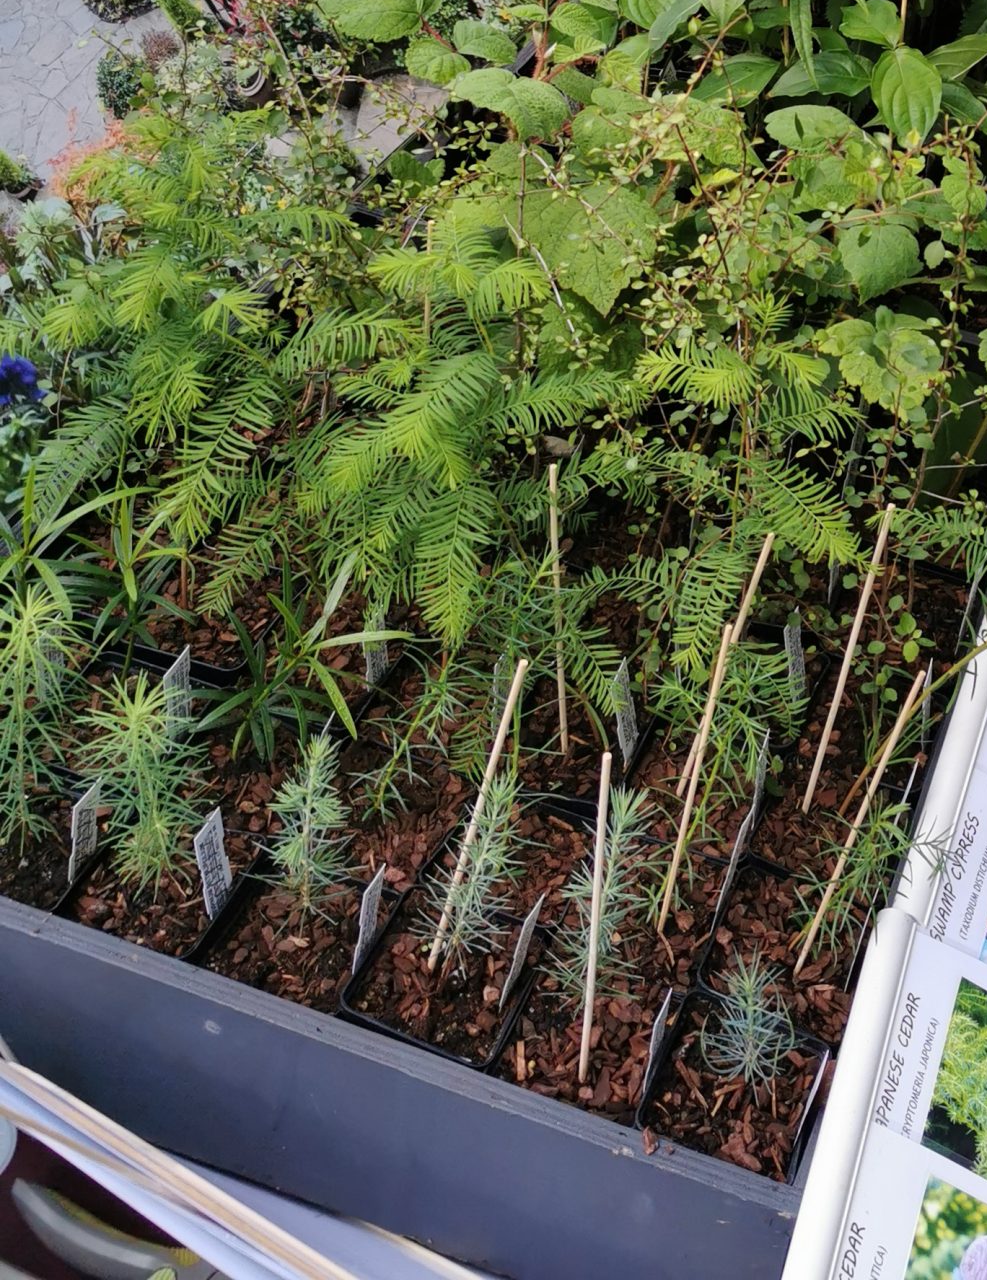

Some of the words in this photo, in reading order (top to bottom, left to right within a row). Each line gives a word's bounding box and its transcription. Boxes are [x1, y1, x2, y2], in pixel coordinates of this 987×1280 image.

[929, 879, 958, 943] SWAMP
[948, 810, 979, 882] CYPRESS
[959, 891, 979, 940] (TAXODIUM
[874, 1049, 904, 1127] APANESE
[897, 992, 920, 1047] CEDAR
[919, 1017, 939, 1070] JAPONICA)
